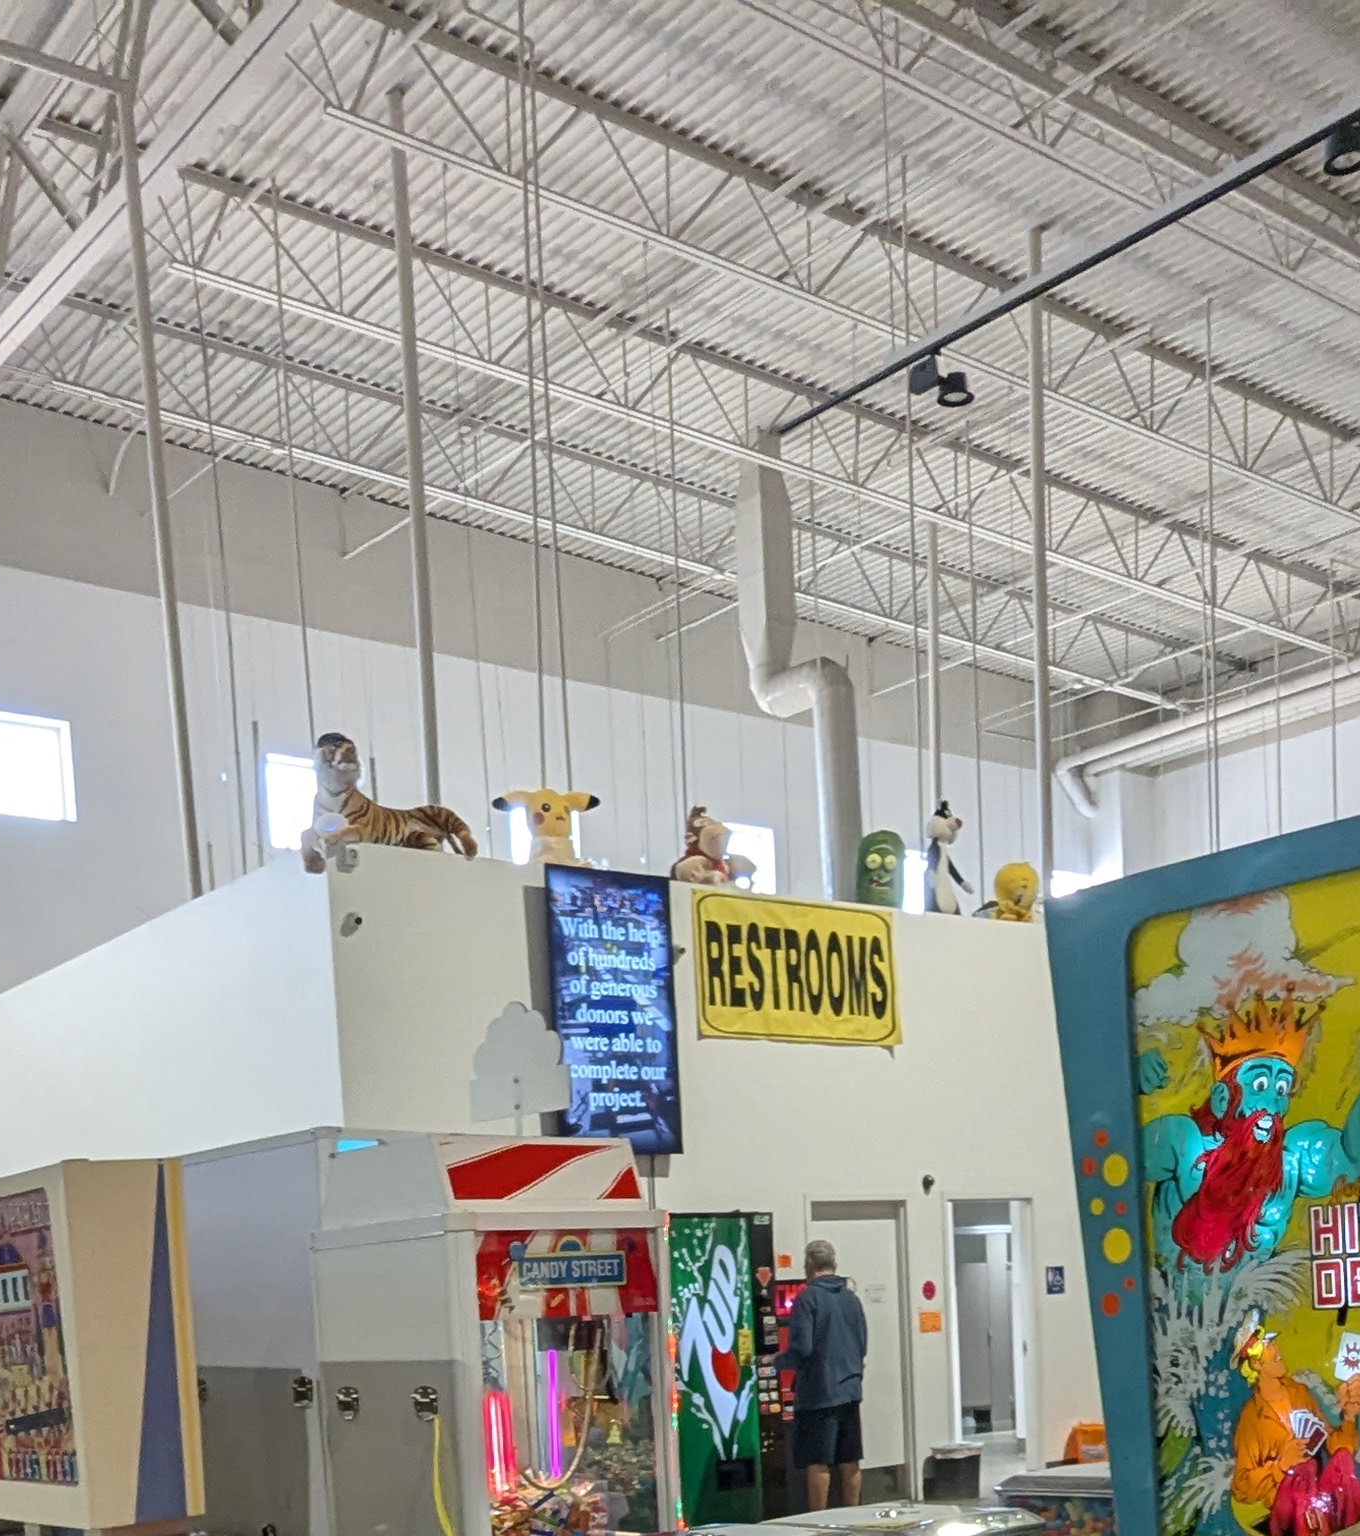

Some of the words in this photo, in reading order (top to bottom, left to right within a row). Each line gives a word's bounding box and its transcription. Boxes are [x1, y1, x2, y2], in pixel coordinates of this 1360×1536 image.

[560, 917, 599, 939] With
[602, 920, 627, 940] the
[630, 925, 660, 947] help
[567, 948, 586, 966] of
[588, 949, 656, 971] hundreds
[704, 920, 888, 1020] RESTROOMS
[570, 976, 589, 994] of
[591, 982, 657, 1000] generous
[576, 1004, 629, 1025] donors
[631, 1011, 653, 1026] we
[571, 1036, 609, 1051] were
[611, 1033, 643, 1054] able
[646, 1037, 662, 1054] to
[570, 1061, 638, 1083] complete
[641, 1066, 667, 1080] our
[589, 1088, 646, 1111] project.
[522, 1260, 568, 1280] CANDY
[571, 1259, 620, 1278] STREET
